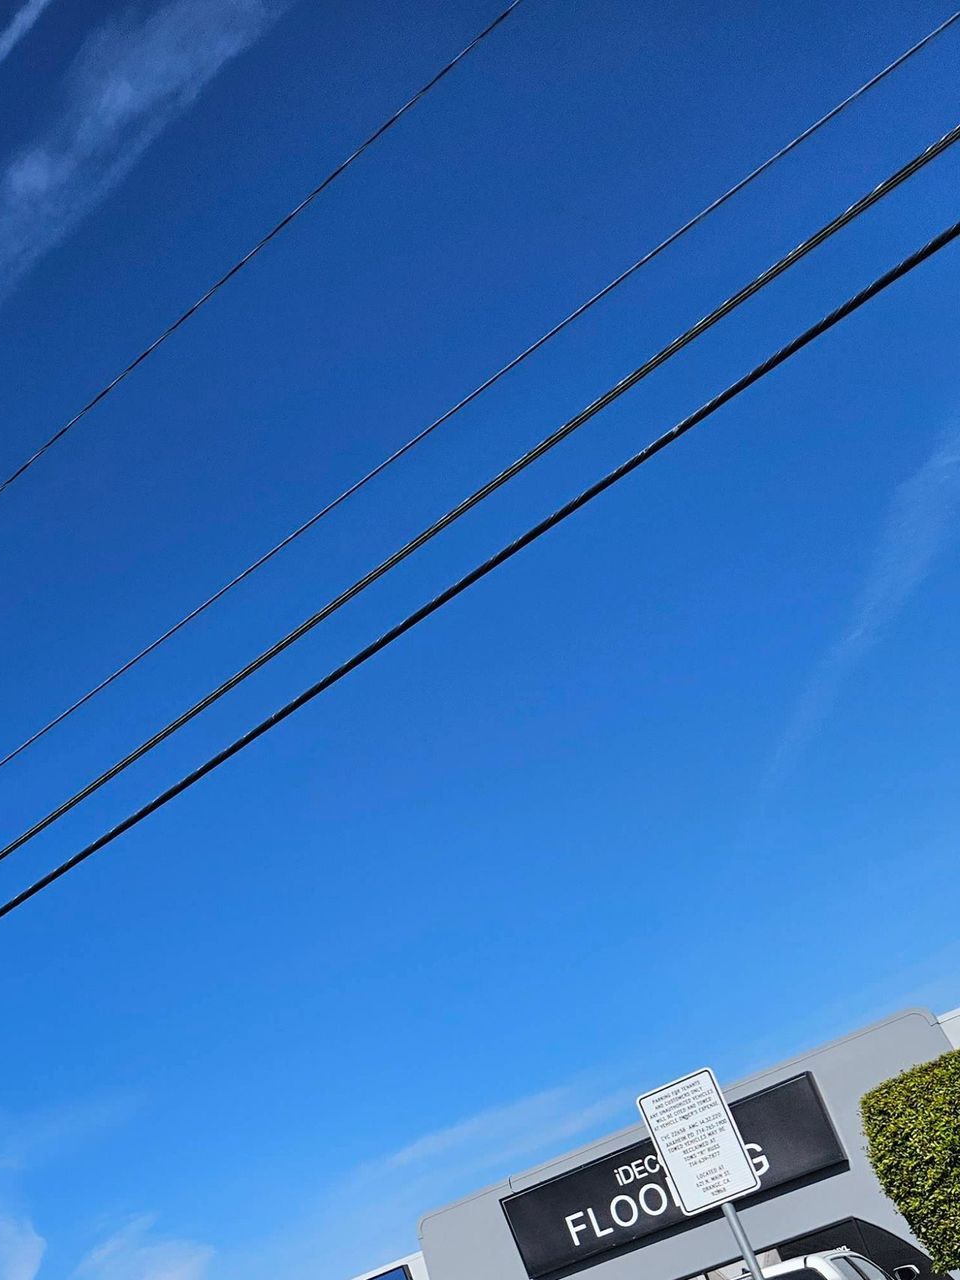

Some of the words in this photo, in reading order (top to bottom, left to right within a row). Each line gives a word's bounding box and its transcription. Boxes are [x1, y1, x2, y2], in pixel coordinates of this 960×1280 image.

[658, 1098, 692, 1114] UNAUTHORIZED
[692, 1088, 713, 1100] VEHICLES
[664, 1092, 690, 1106] CUSTOMERS
[690, 1086, 702, 1094] ONLY
[673, 1107, 686, 1115] CITED
[696, 1096, 711, 1105] TOWED
[660, 1118, 678, 1128] VEHICLE
[678, 1109, 698, 1120] OWNER'S
[698, 1101, 718, 1112] EXPENSE
[665, 1135, 687, 1147] ANAHEIM
[668, 1143, 684, 1153] TOWED
[684, 1133, 706, 1146] VEHICLES
[682, 1140, 709, 1154] RECLAIMED
[614, 1154, 668, 1186] iDEC
[696, 1167, 717, 1179] LOCATED
[710, 1173, 723, 1181] MAIN
[565, 1143, 770, 1247] FLOOG
